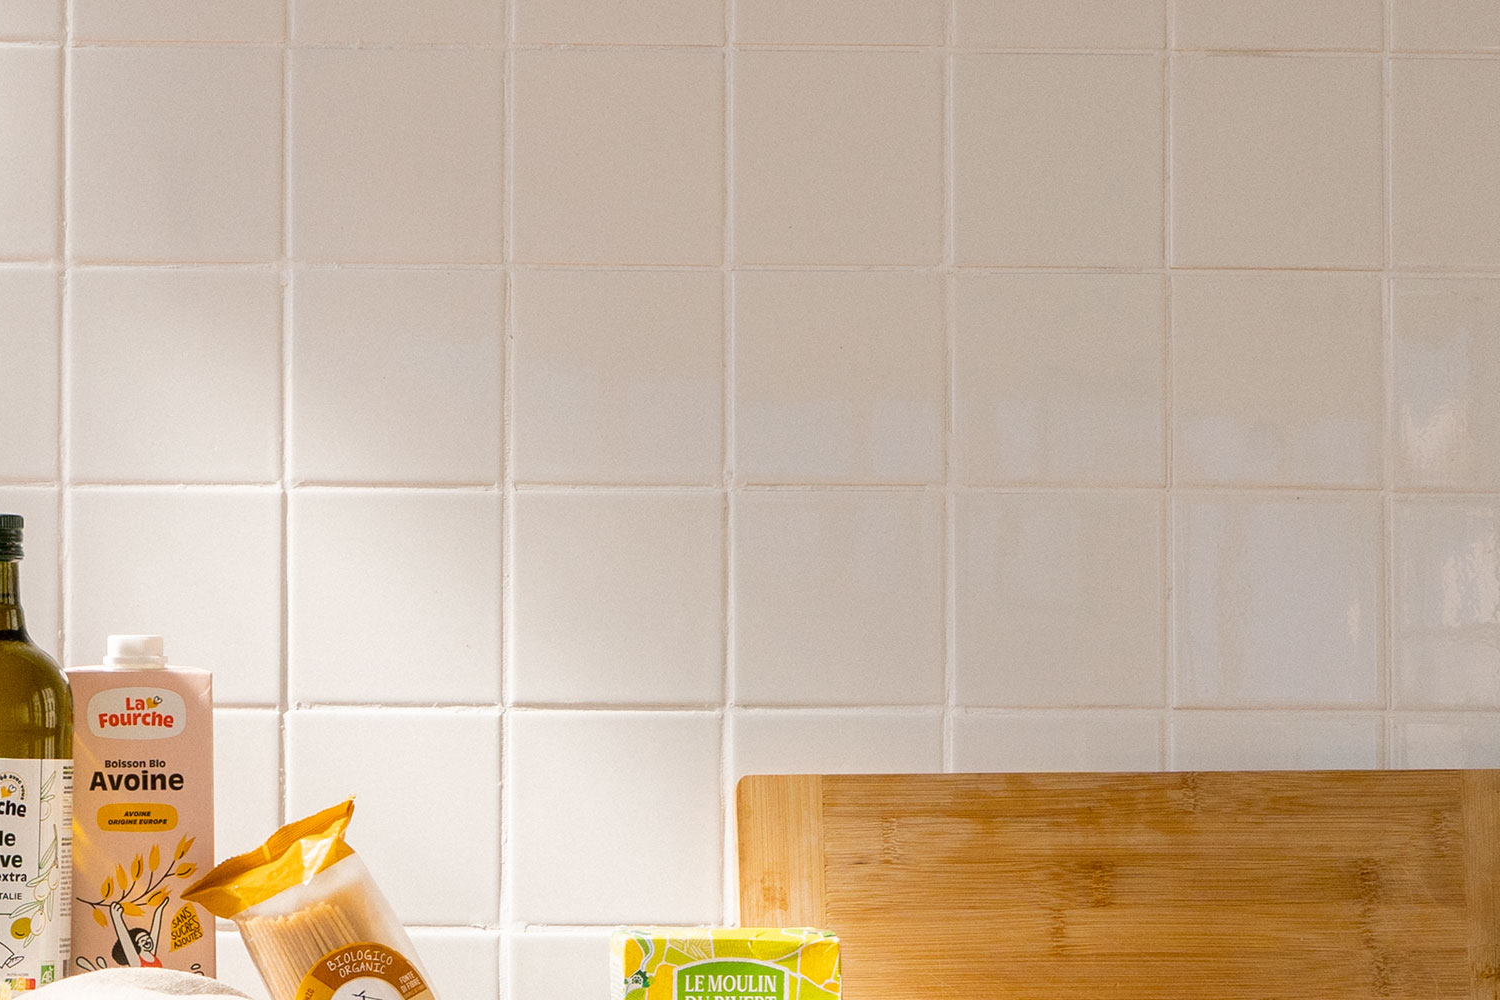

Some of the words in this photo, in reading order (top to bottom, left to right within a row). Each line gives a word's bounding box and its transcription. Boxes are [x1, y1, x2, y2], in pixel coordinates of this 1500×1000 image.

[125, 697, 145, 711] La
[98, 712, 174, 728] Fourche
[105, 759, 146, 768] Boisson
[149, 759, 166, 768] Bio
[89, 770, 184, 791] Avoine
[172, 906, 192, 928] SANS
[326, 950, 393, 972] BIOLOGICO
[339, 960, 386, 978] ORGANIC
[685, 975, 705, 992] LE
[707, 975, 777, 992] MOULIN
